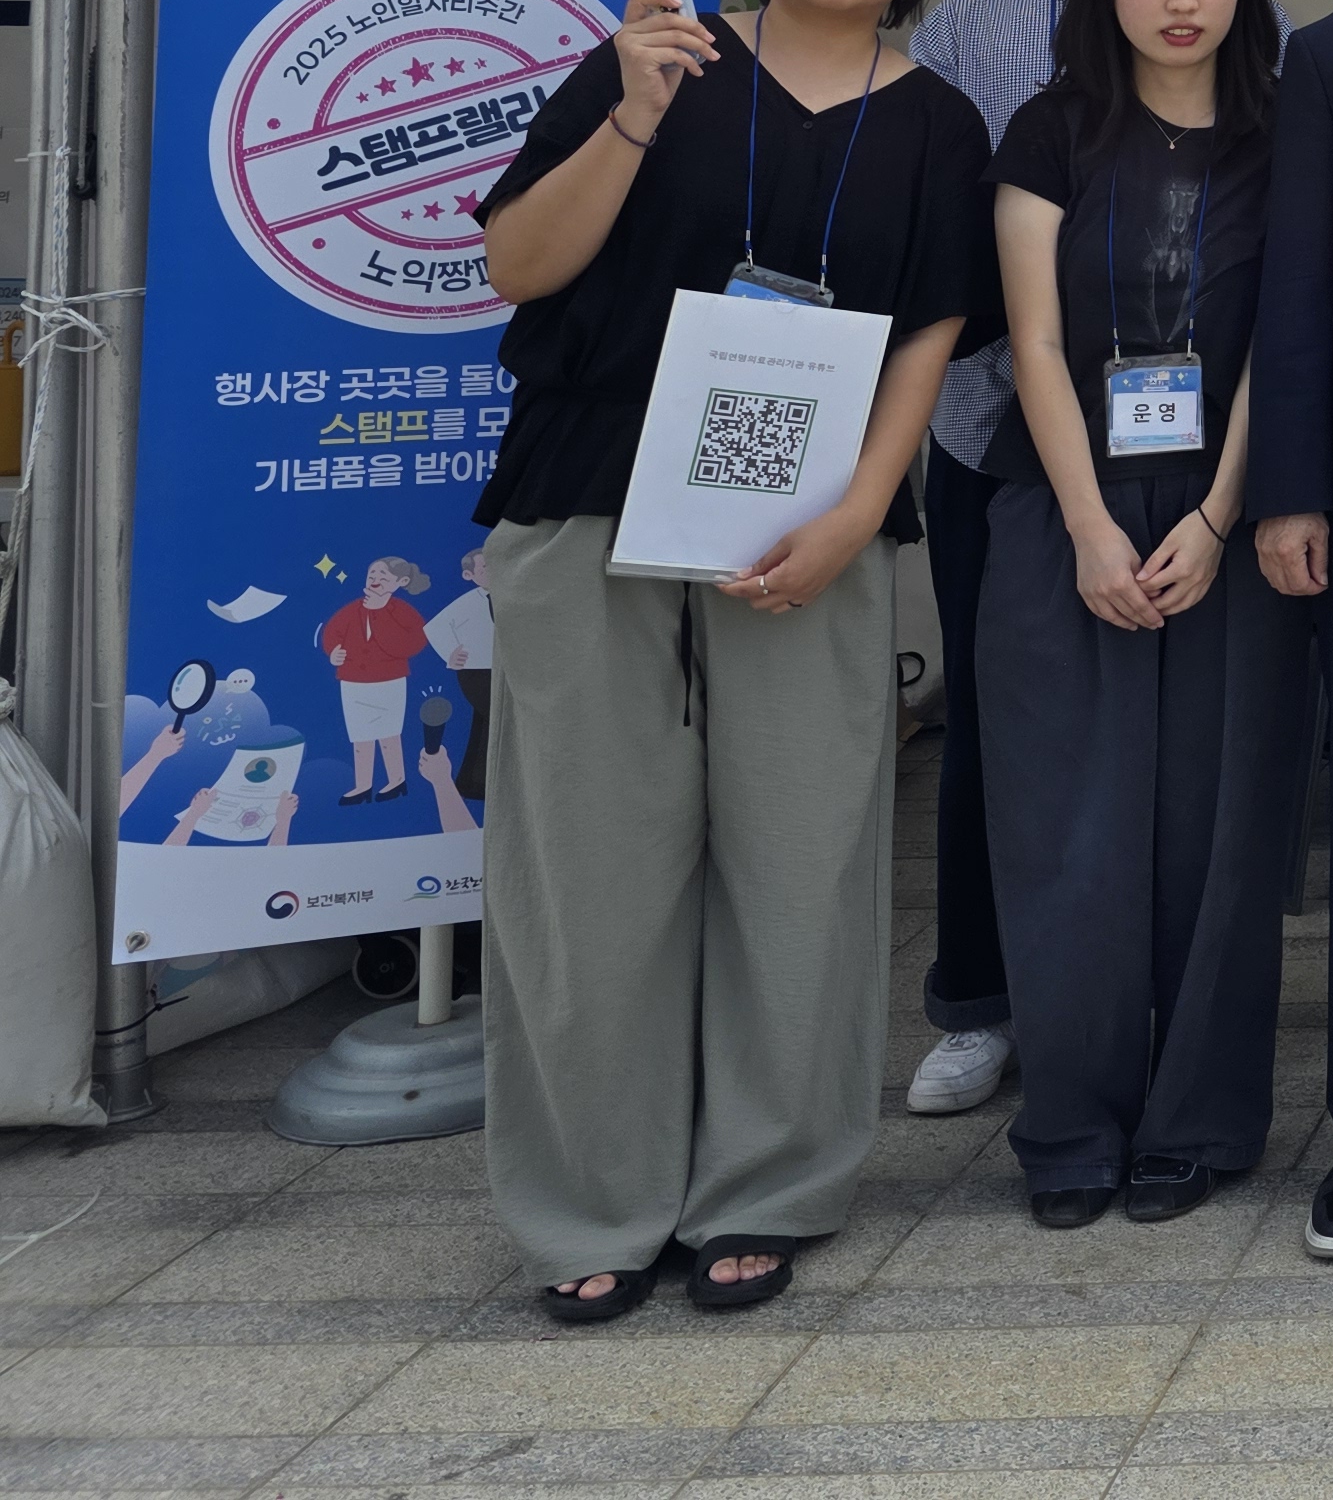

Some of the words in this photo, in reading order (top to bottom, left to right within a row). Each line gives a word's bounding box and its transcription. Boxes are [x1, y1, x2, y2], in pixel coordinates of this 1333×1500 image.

[282, 23, 348, 87] 2025
[316, 85, 548, 193] 스탬프랠리
[708, 349, 805, 370] 국립연명의료관리기관
[808, 361, 836, 373] 유튜브
[215, 370, 327, 407] 행사장
[339, 366, 450, 401] 곳곳을
[318, 409, 467, 446] 스탬프를
[476, 406, 511, 438] 모
[1132, 403, 1152, 424] 운
[1158, 402, 1176, 423] 영
[253, 455, 404, 493] 기념품을
